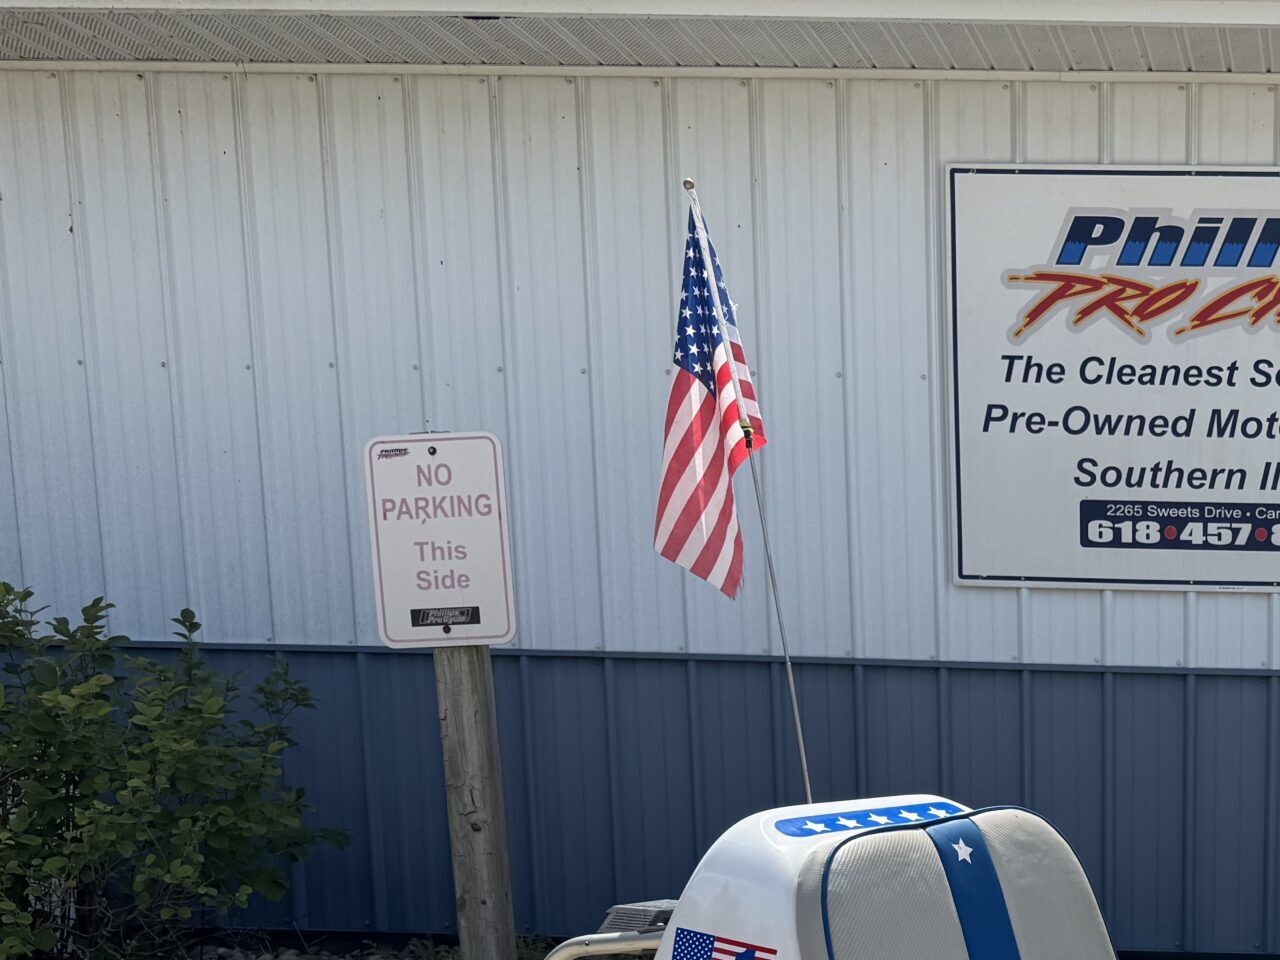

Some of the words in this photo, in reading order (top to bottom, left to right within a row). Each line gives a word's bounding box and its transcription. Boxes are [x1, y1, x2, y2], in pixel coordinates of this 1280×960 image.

[1008, 272, 1201, 338] PRO
[1001, 355, 1067, 384] The
[1079, 357, 1239, 388] Cleanest
[982, 404, 1196, 438] Pre-Owned
[416, 463, 452, 487] NO
[1074, 458, 1248, 490] Southern
[382, 493, 493, 521] PARKING
[1106, 504, 1143, 517] 2265
[1147, 505, 1200, 518] Sweets
[1204, 506, 1242, 519] Drive
[413, 540, 468, 563] This
[416, 569, 471, 591] Side
